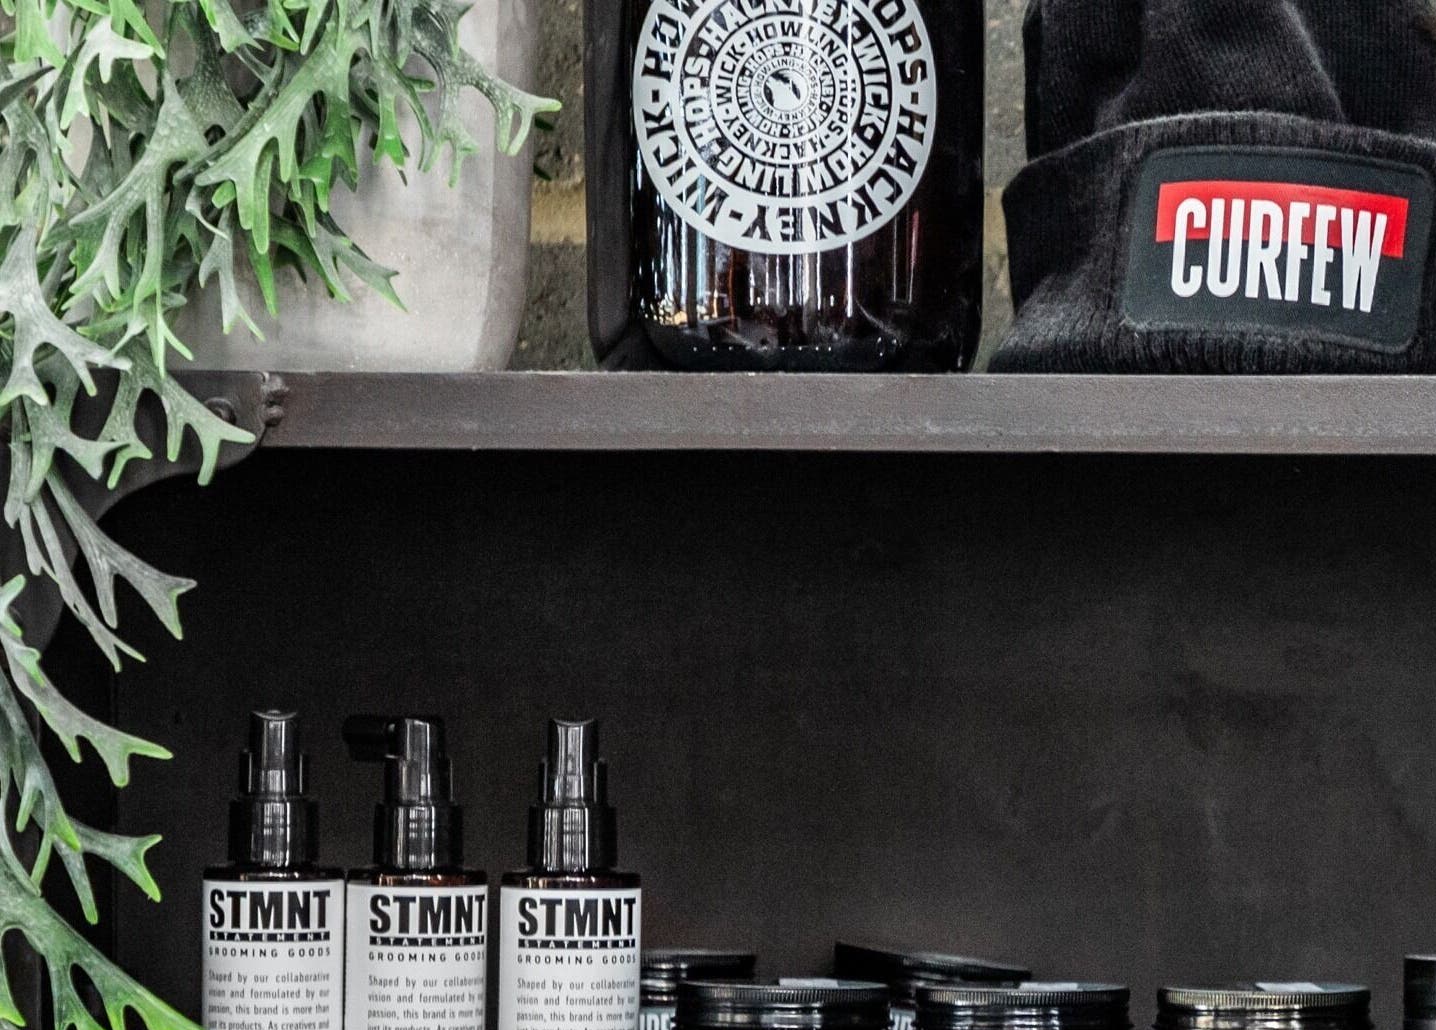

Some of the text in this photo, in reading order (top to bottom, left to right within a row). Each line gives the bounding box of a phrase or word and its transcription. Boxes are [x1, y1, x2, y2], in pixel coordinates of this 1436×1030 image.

[1170, 197, 1388, 312] CURFEW
[210, 889, 330, 929] STMNT
[369, 894, 485, 934] STMNT
[518, 897, 636, 937] STMNT
[369, 951, 447, 962] GROOMING
[518, 955, 593, 965] GROOMING
